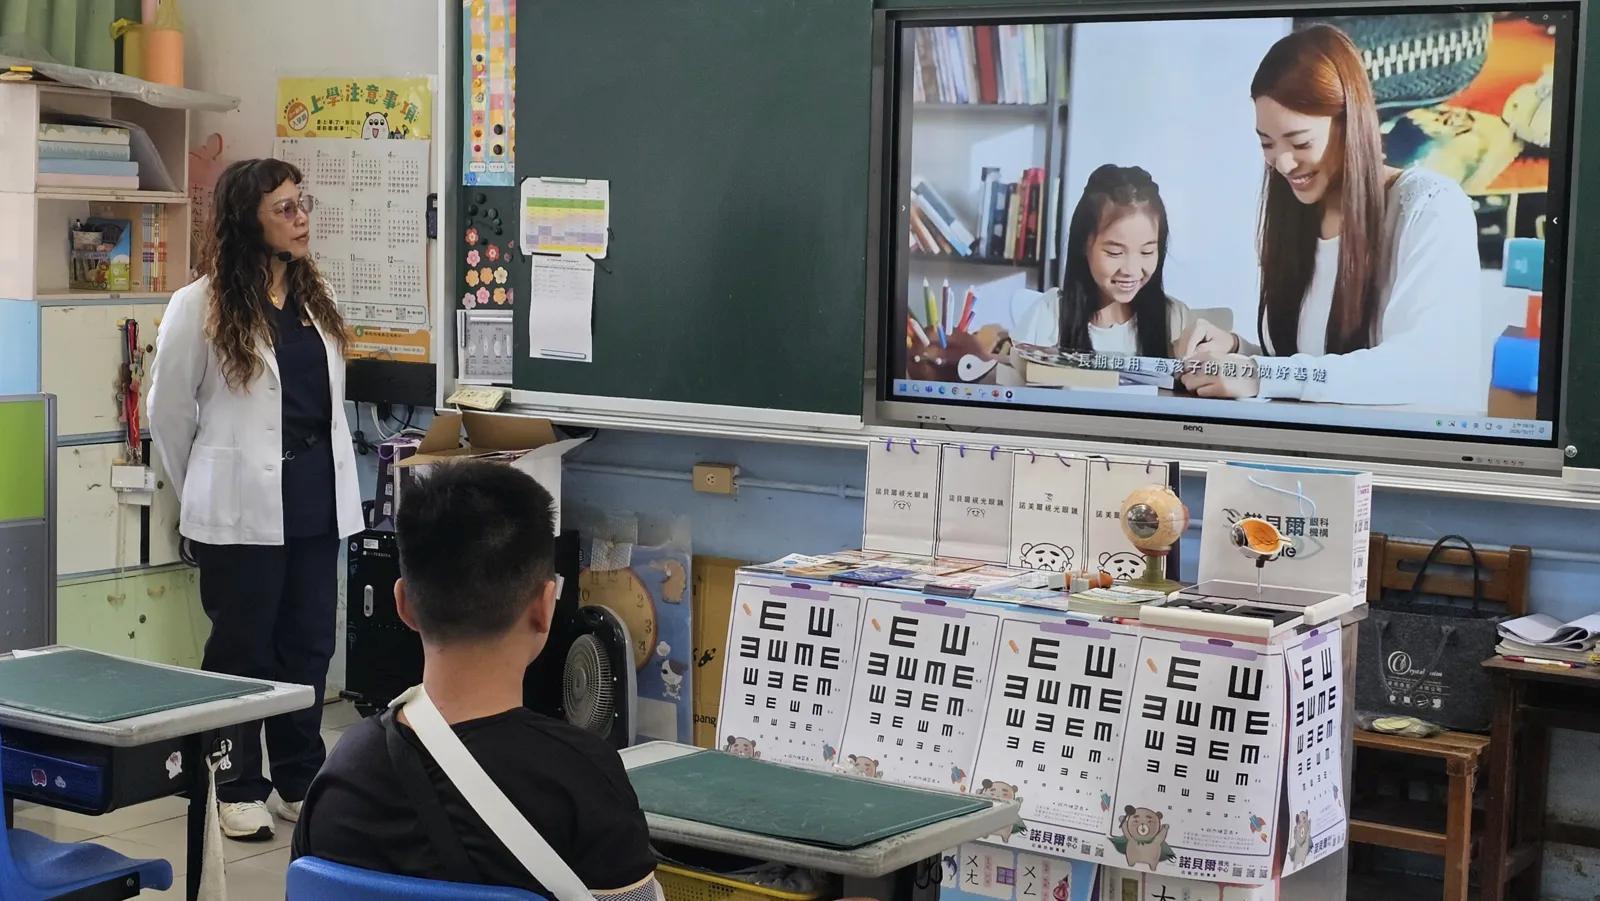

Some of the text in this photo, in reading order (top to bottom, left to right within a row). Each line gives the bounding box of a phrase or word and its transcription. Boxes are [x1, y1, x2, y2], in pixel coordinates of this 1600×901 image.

[310, 82, 418, 124] 上學注意事項
[1078, 353, 1329, 383] 長期使用 為孩子的視力做好基礎
[1244, 512, 1306, 537] 貝爾
[1310, 517, 1329, 527] 眼科
[1310, 527, 1329, 538] 機構
[1029, 828, 1066, 846] 諾貝爾
[1179, 855, 1217, 872] 諾貝爾
